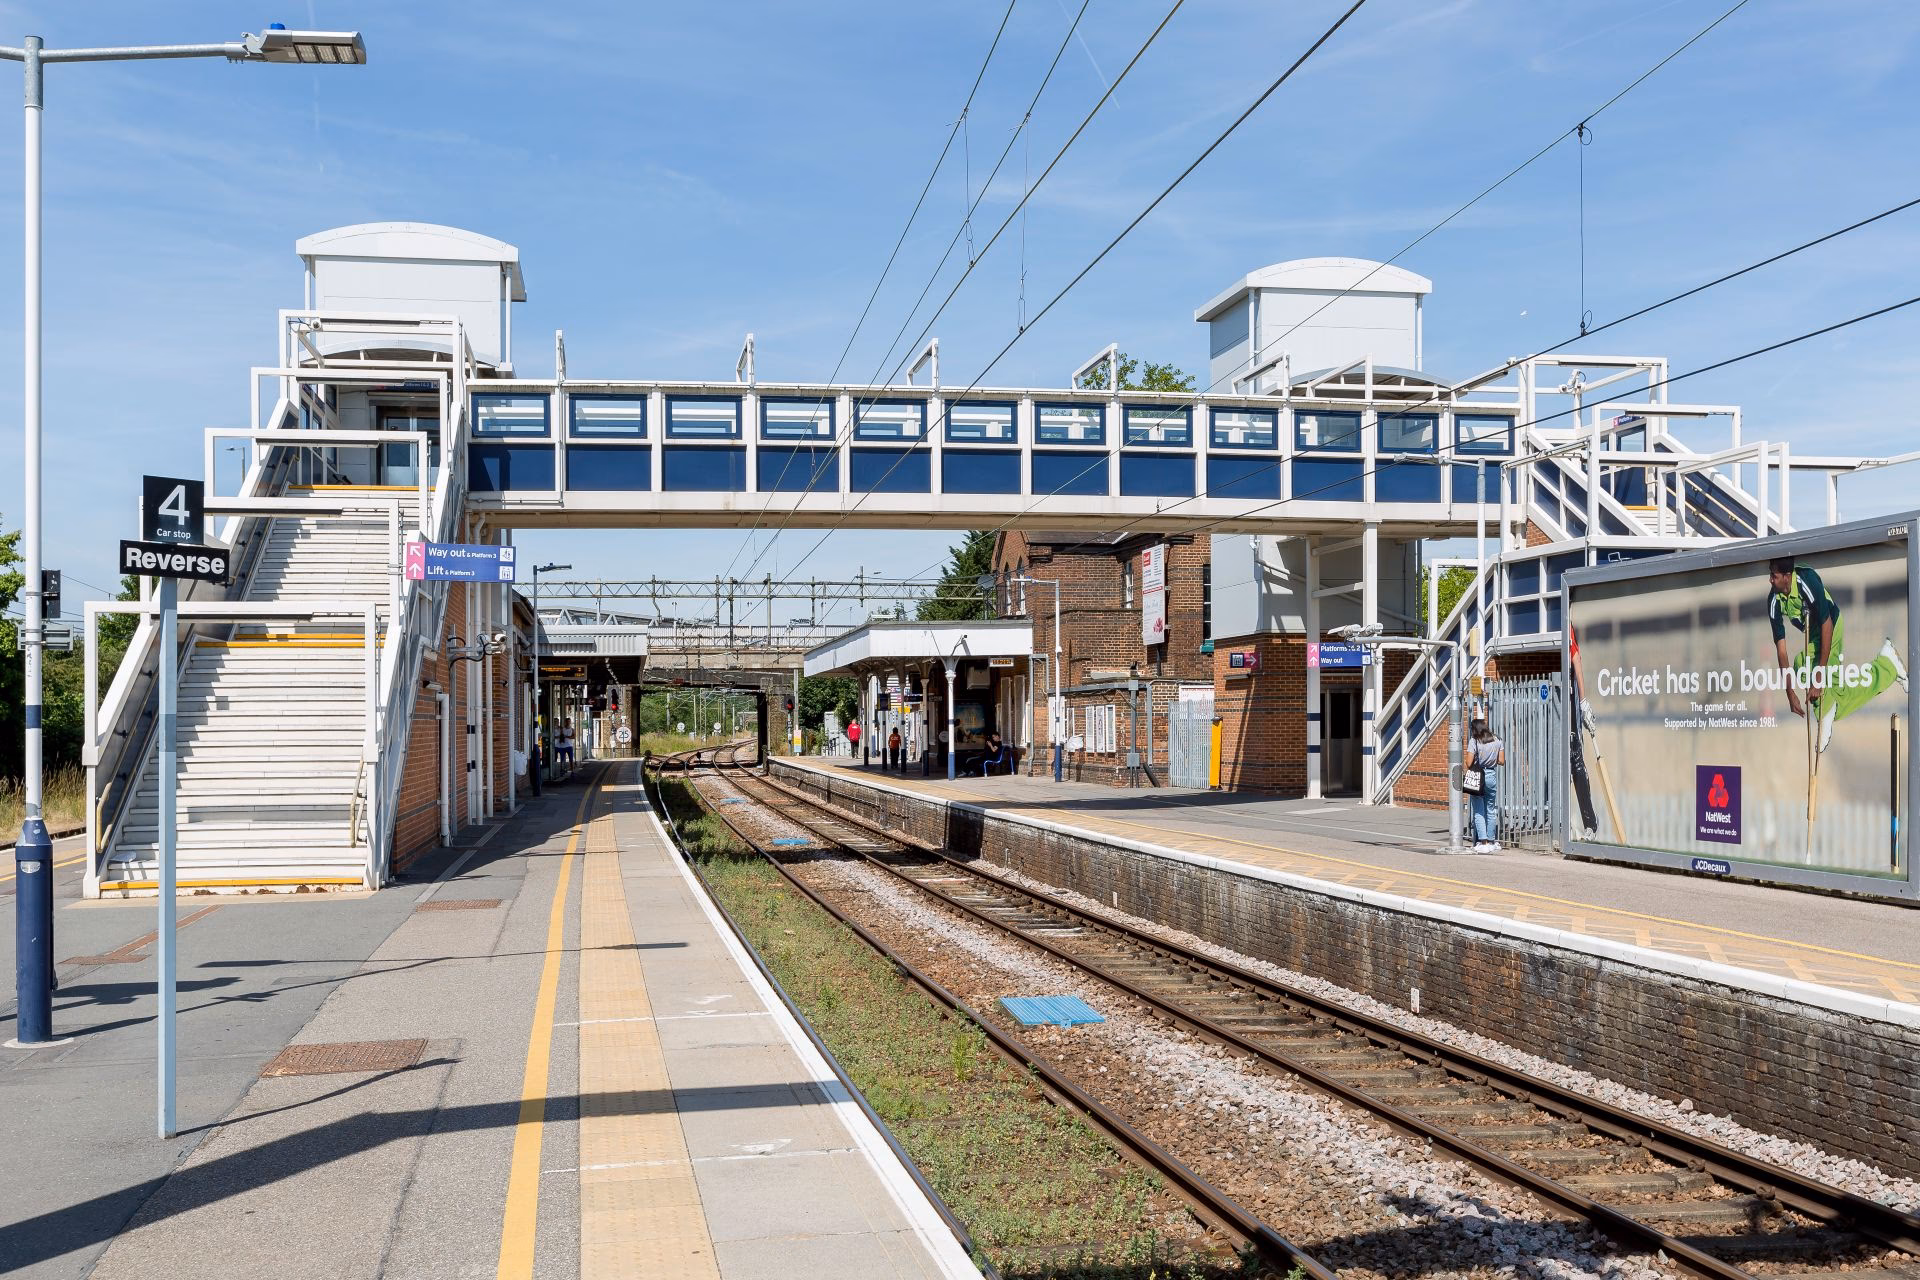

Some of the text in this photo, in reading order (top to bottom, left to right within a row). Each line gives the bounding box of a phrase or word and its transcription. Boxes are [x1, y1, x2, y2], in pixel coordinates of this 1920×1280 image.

[158, 484, 190, 526] 4
[156, 528, 191, 539] Car stop
[428, 547, 448, 558] Way
[450, 548, 466, 558] out
[126, 547, 225, 575] Reverse
[427, 565, 444, 575] Lift
[1320, 643, 1347, 652] Platforms
[1597, 653, 1873, 697] Cricket has no boundaries
[1691, 700, 1748, 714] The game for all.
[1664, 716, 1778, 731] Supported by NatWest since 1981.
[618, 729, 629, 739] 25
[1705, 811, 1731, 823] NatWest
[1714, 827, 1725, 835] what
[1695, 860, 1727, 872] JCDecaux
